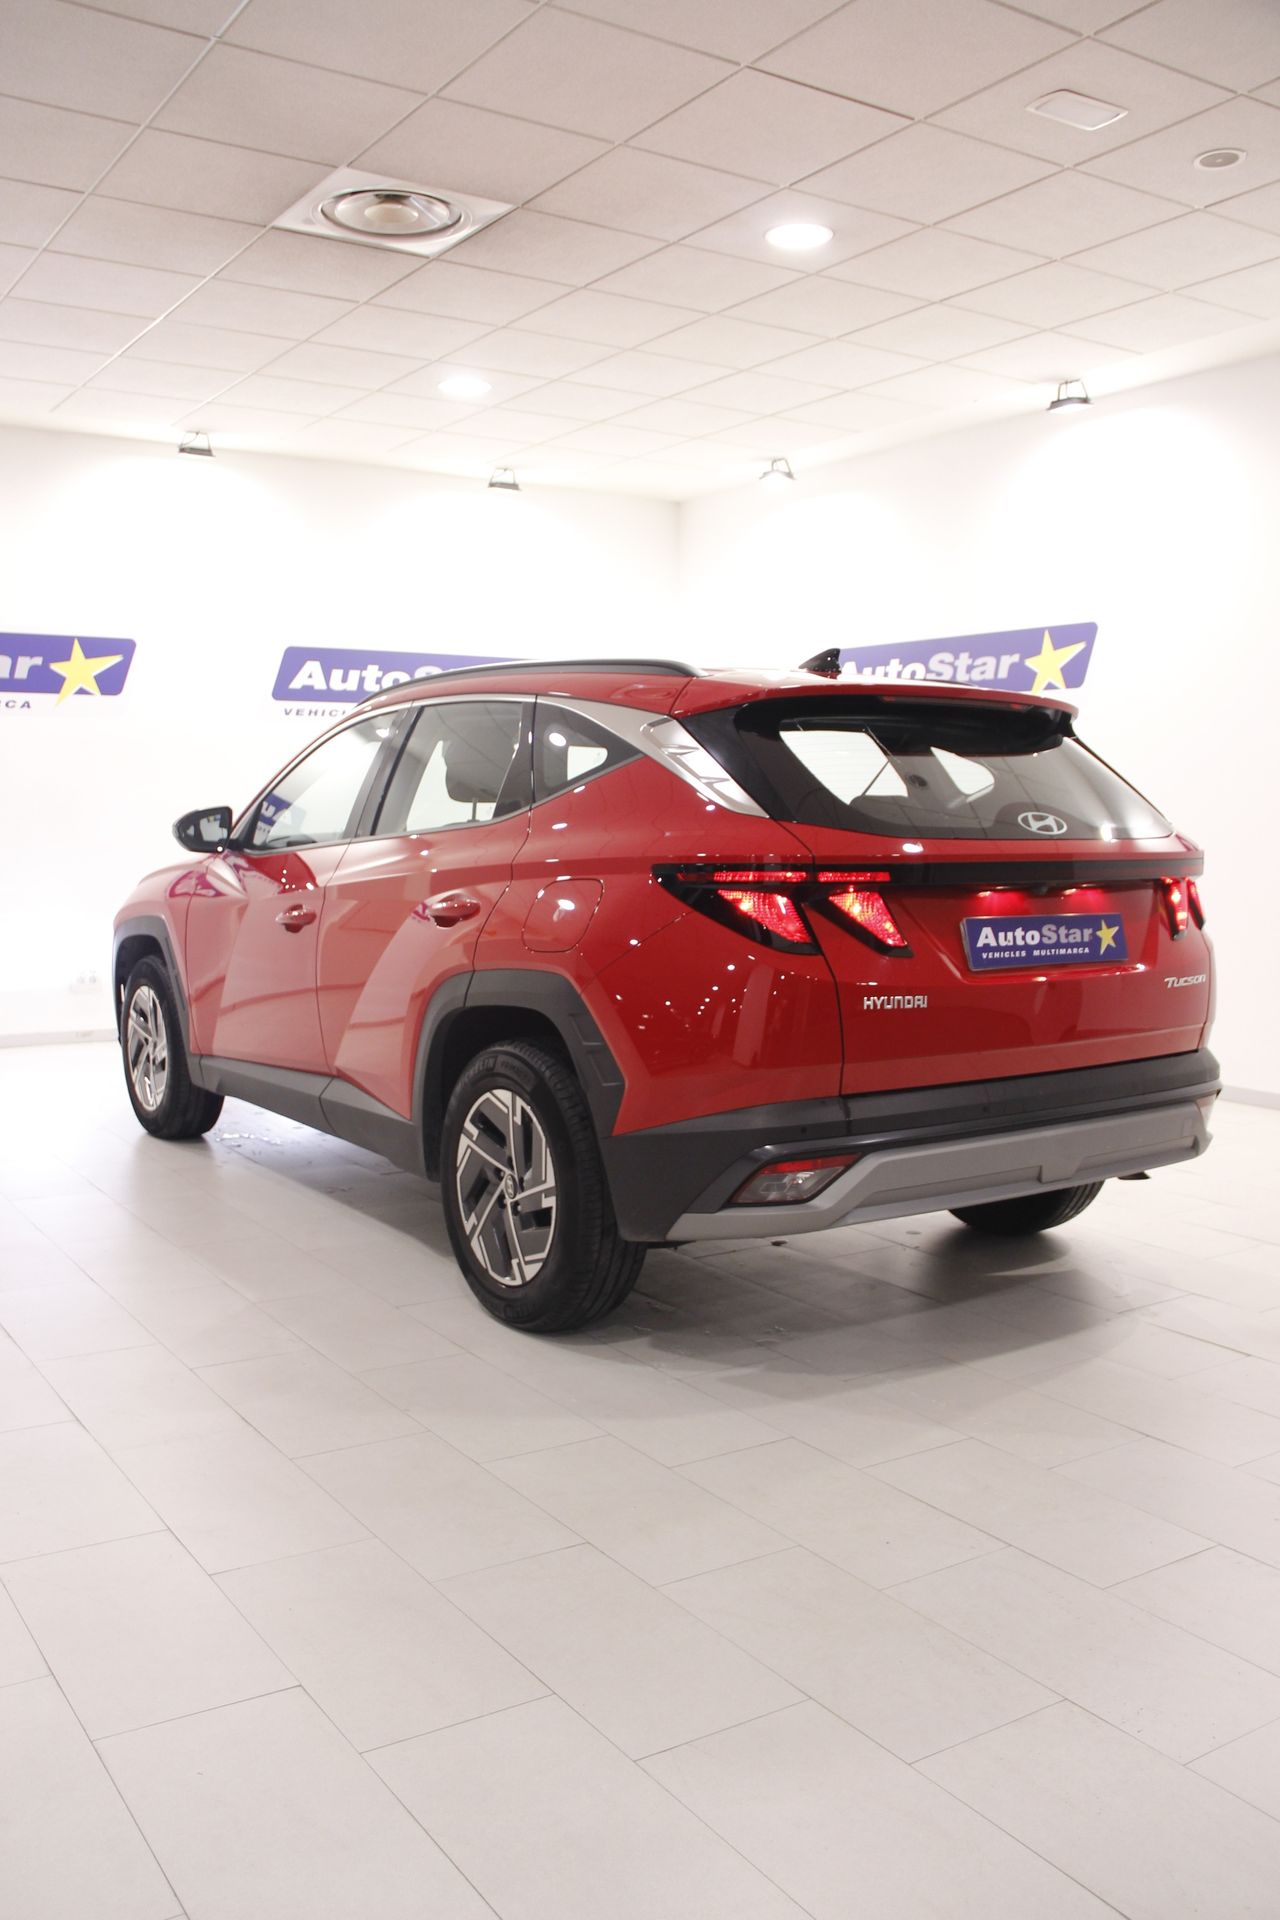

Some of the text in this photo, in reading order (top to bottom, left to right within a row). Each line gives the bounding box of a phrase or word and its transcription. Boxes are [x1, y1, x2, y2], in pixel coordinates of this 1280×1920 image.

[0, 699, 31, 709] CA
[976, 924, 1093, 948] AutoStar
[982, 947, 1090, 959] VEHICLES MULTIMARCA
[863, 995, 928, 1010] HYUNDAI
